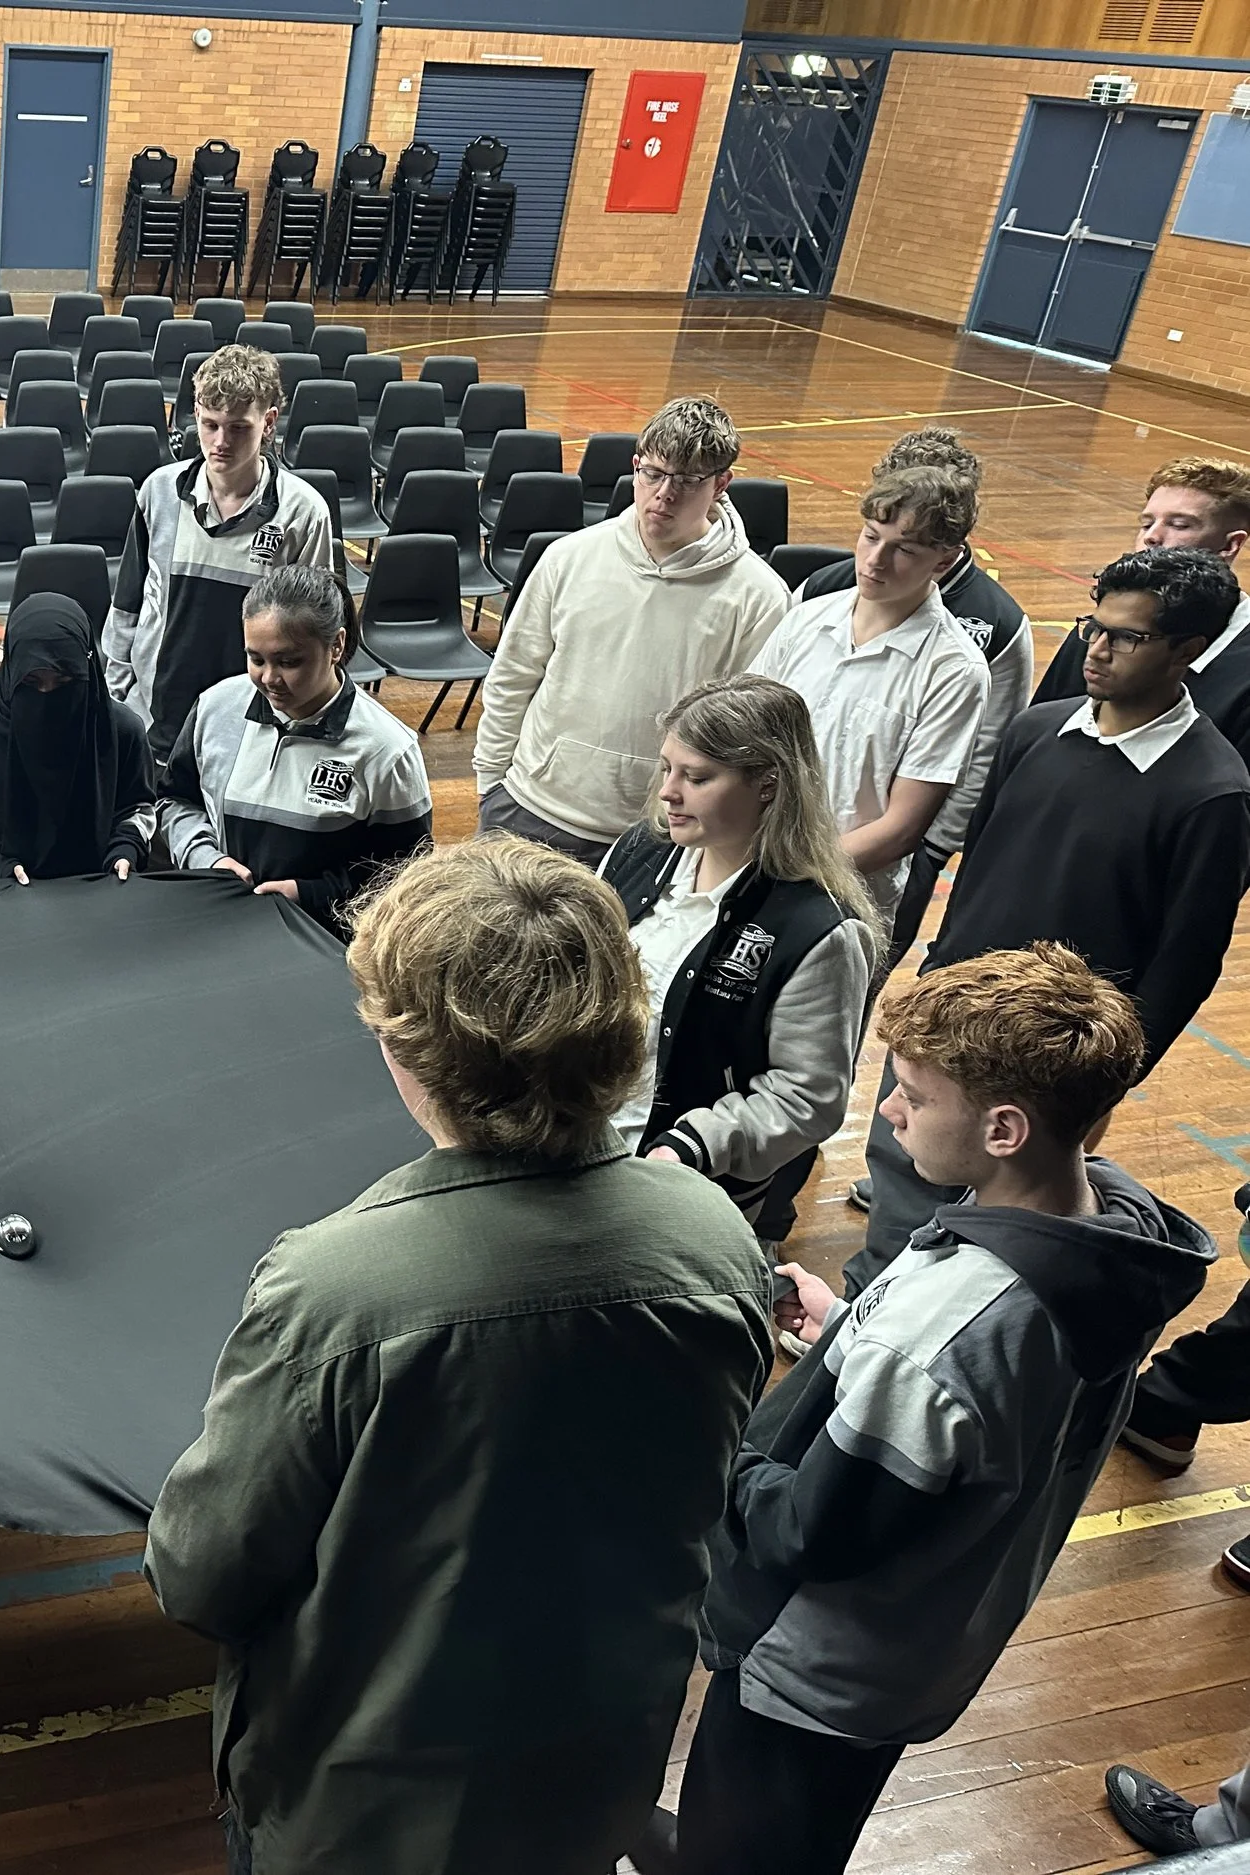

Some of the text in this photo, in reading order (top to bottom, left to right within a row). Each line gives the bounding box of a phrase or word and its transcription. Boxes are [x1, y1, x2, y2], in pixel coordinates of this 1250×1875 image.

[646, 101, 680, 112] FIRE HOSE
[652, 112, 668, 122] REEL
[254, 531, 282, 551] LHS
[313, 767, 350, 793] LHS
